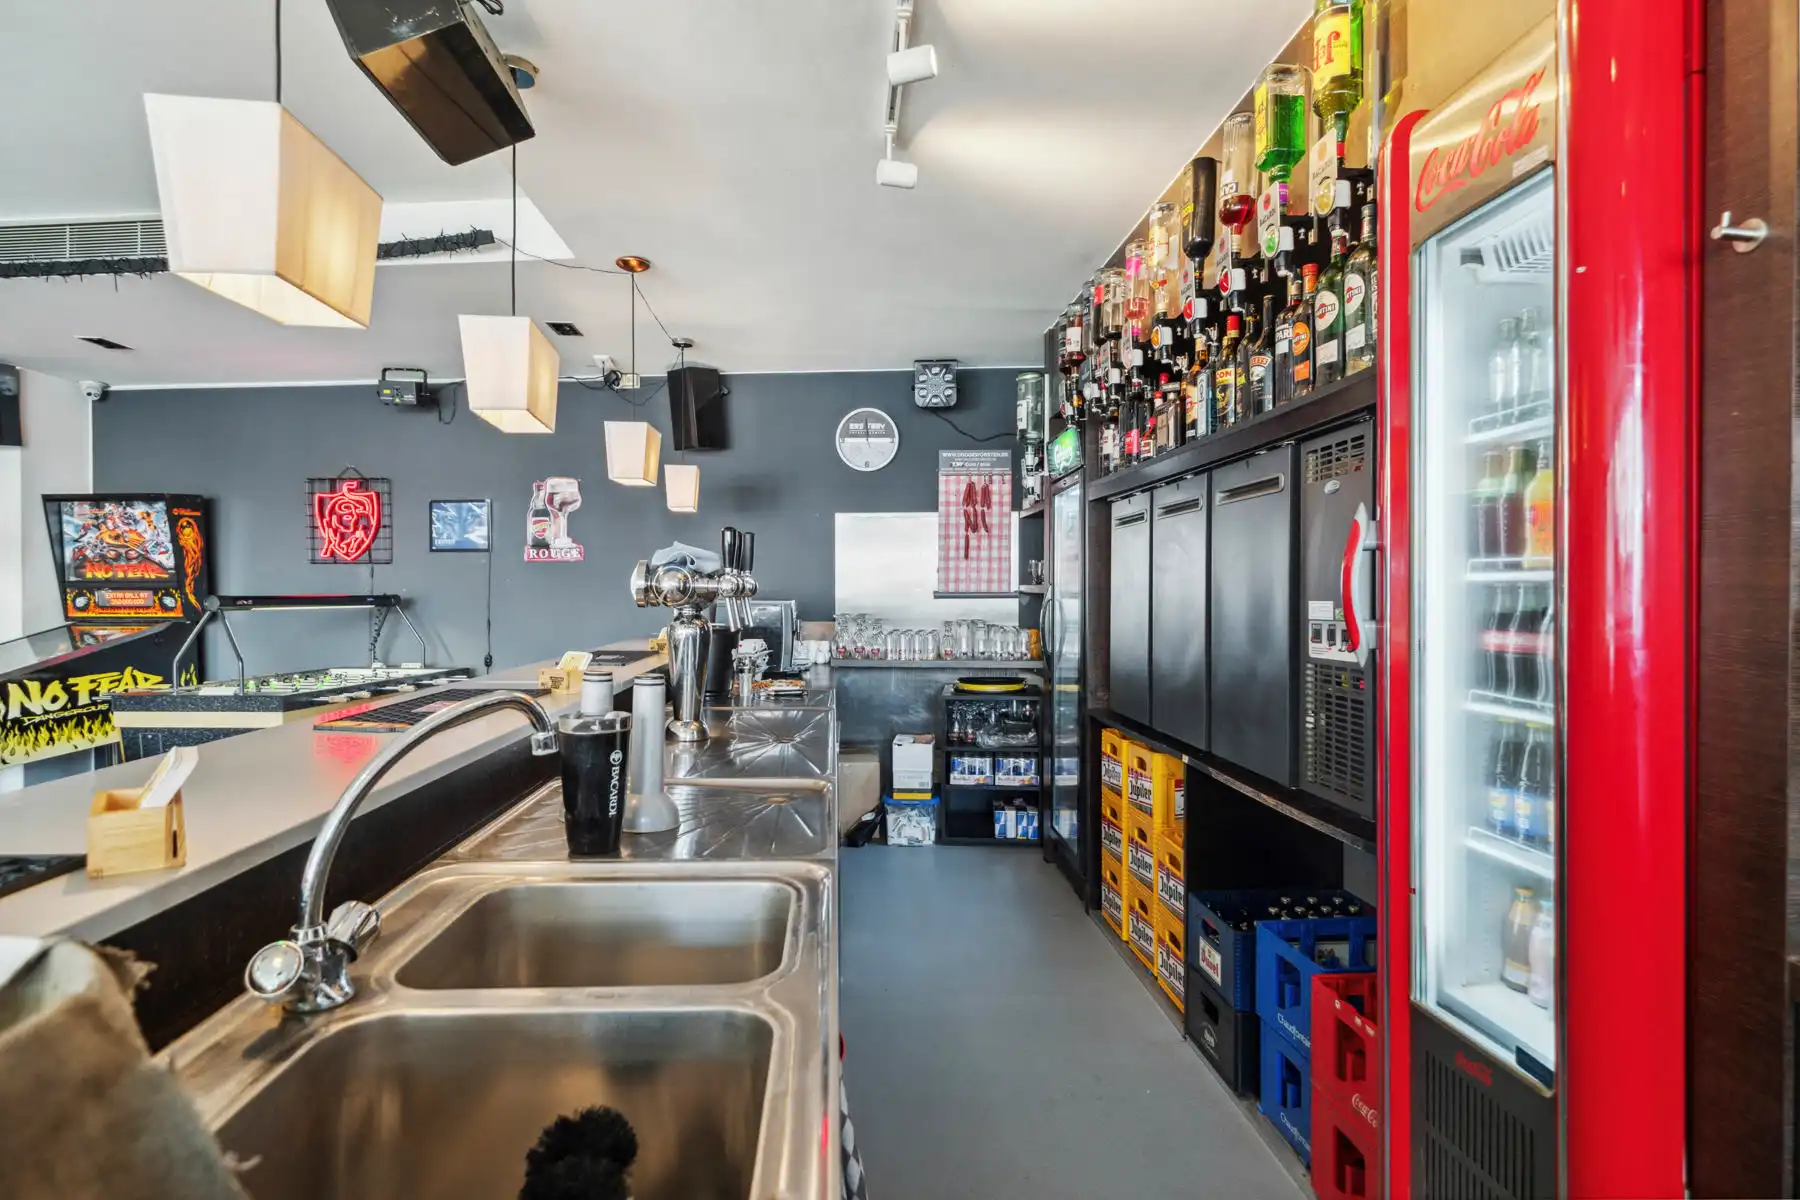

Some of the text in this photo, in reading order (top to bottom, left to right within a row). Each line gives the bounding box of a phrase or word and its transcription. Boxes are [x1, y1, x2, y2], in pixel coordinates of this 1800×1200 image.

[529, 548, 581, 559] ROUGE
[86, 562, 169, 578] NO FEAR
[7, 666, 174, 720] NO FEAR
[19, 702, 110, 726] DANGEROUS
[608, 766, 620, 818] BACARDI
[1130, 780, 1152, 801] Jupiler
[1130, 849, 1153, 875] Jupiler
[1160, 875, 1185, 902] Jupile
[1130, 917, 1154, 947] Jupiler
[1160, 951, 1185, 986] Jupile
